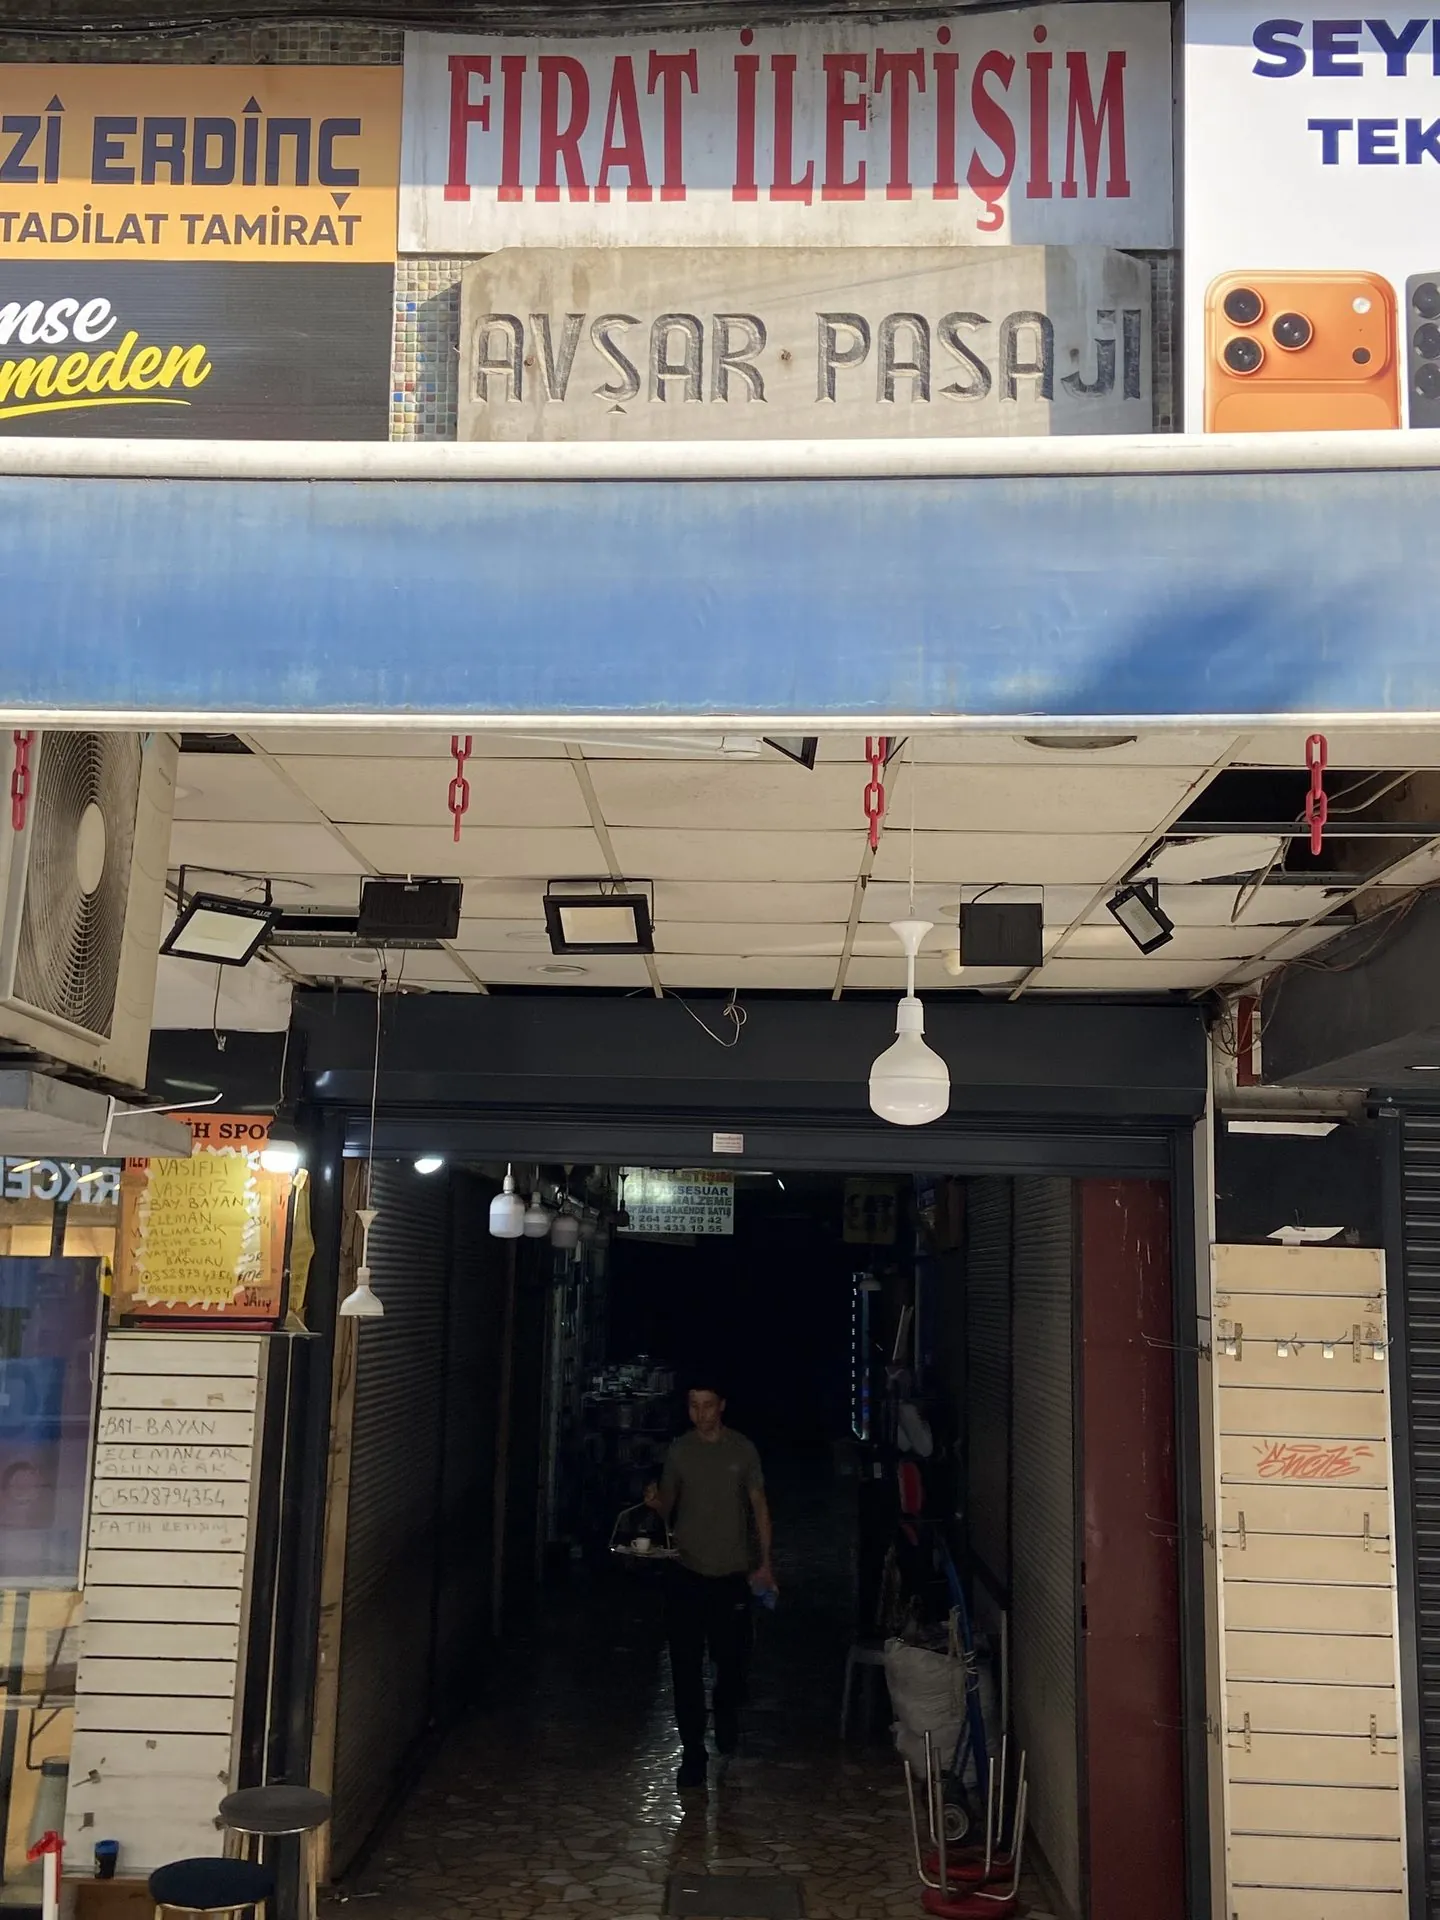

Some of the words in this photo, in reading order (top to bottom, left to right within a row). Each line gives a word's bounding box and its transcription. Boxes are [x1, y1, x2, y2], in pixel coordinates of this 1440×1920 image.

[1252, 18, 1440, 78] SEY
[91, 95, 361, 209] ERDİNÇ
[444, 48, 699, 202] FIRAT
[732, 24, 1131, 231] İLETİŞİM
[0, 203, 169, 245] TADİLAT
[180, 205, 362, 246] TAMİRAT
[477, 312, 767, 415] AVŞAR
[219, 1122, 273, 1140] SPO
[158, 1159, 229, 1177] VASIFLI
[663, 1215, 685, 1224] 277
